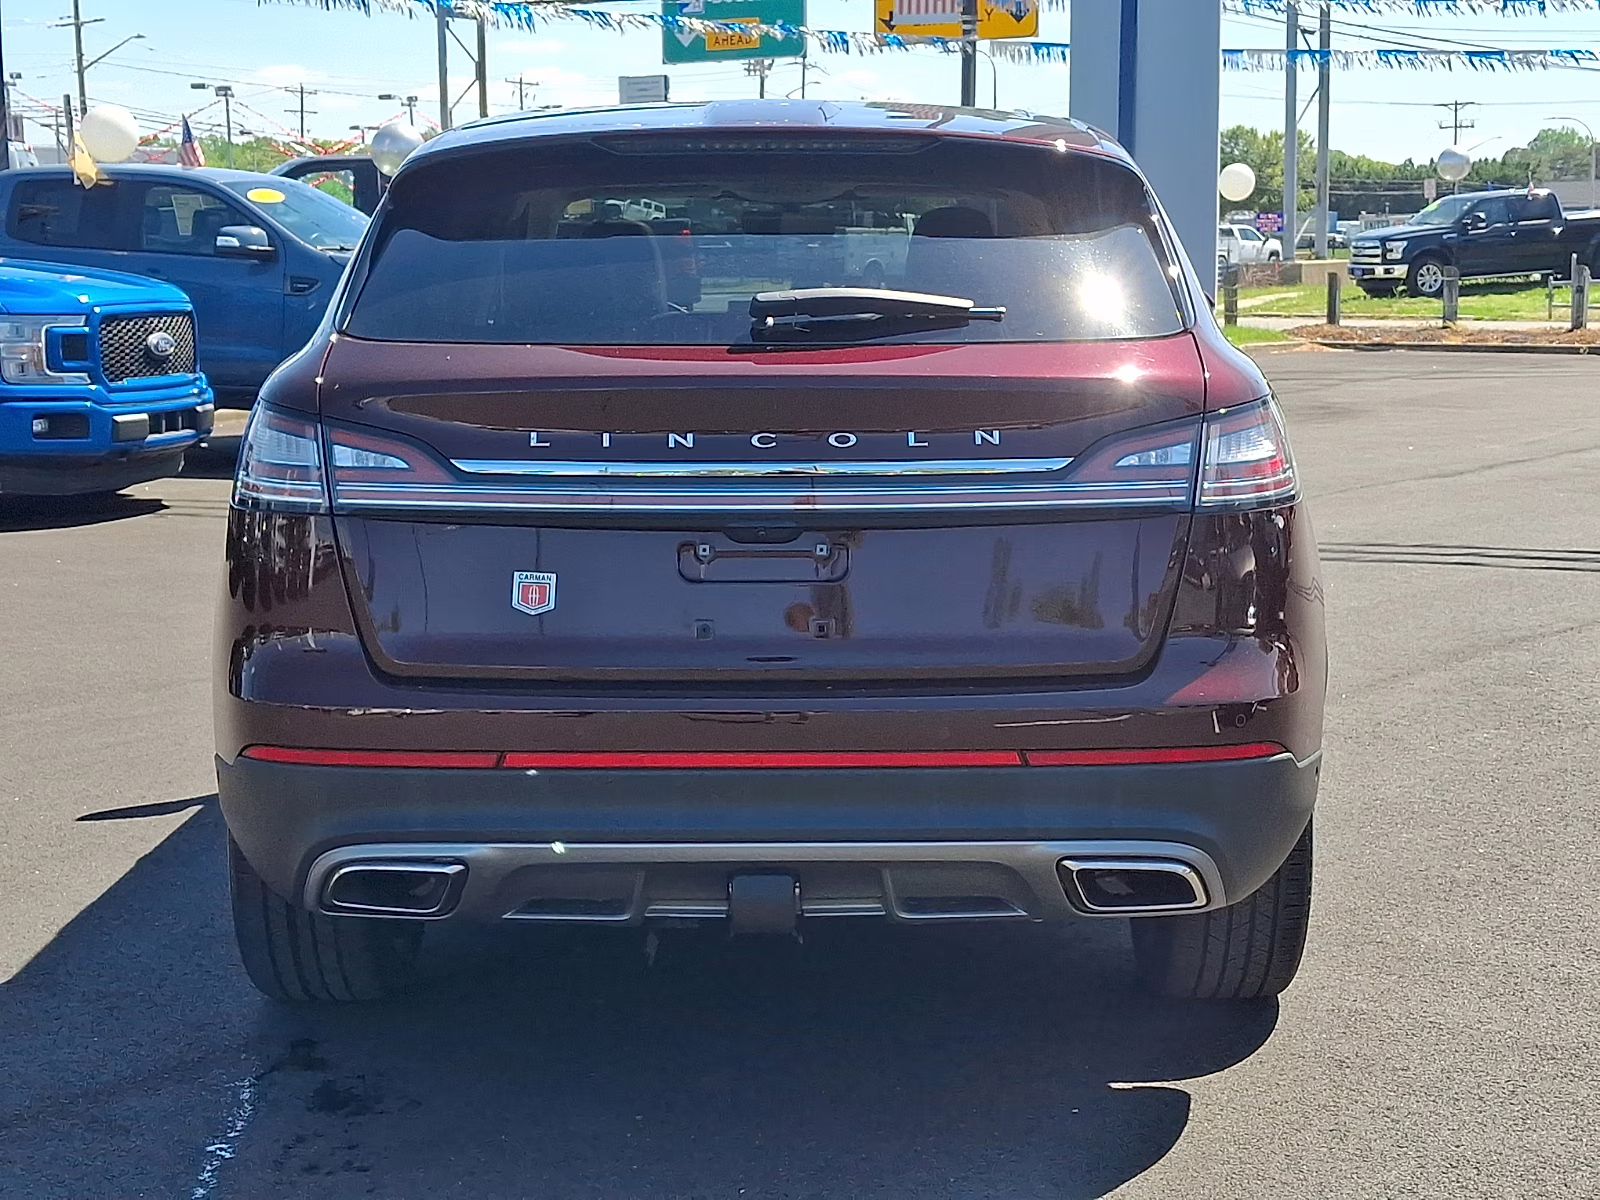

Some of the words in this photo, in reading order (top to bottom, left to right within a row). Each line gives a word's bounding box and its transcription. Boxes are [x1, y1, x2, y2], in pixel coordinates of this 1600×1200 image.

[713, 35, 753, 47] AHEAD
[530, 429, 1000, 448] LINCOLN
[518, 573, 552, 582] CARMAN
